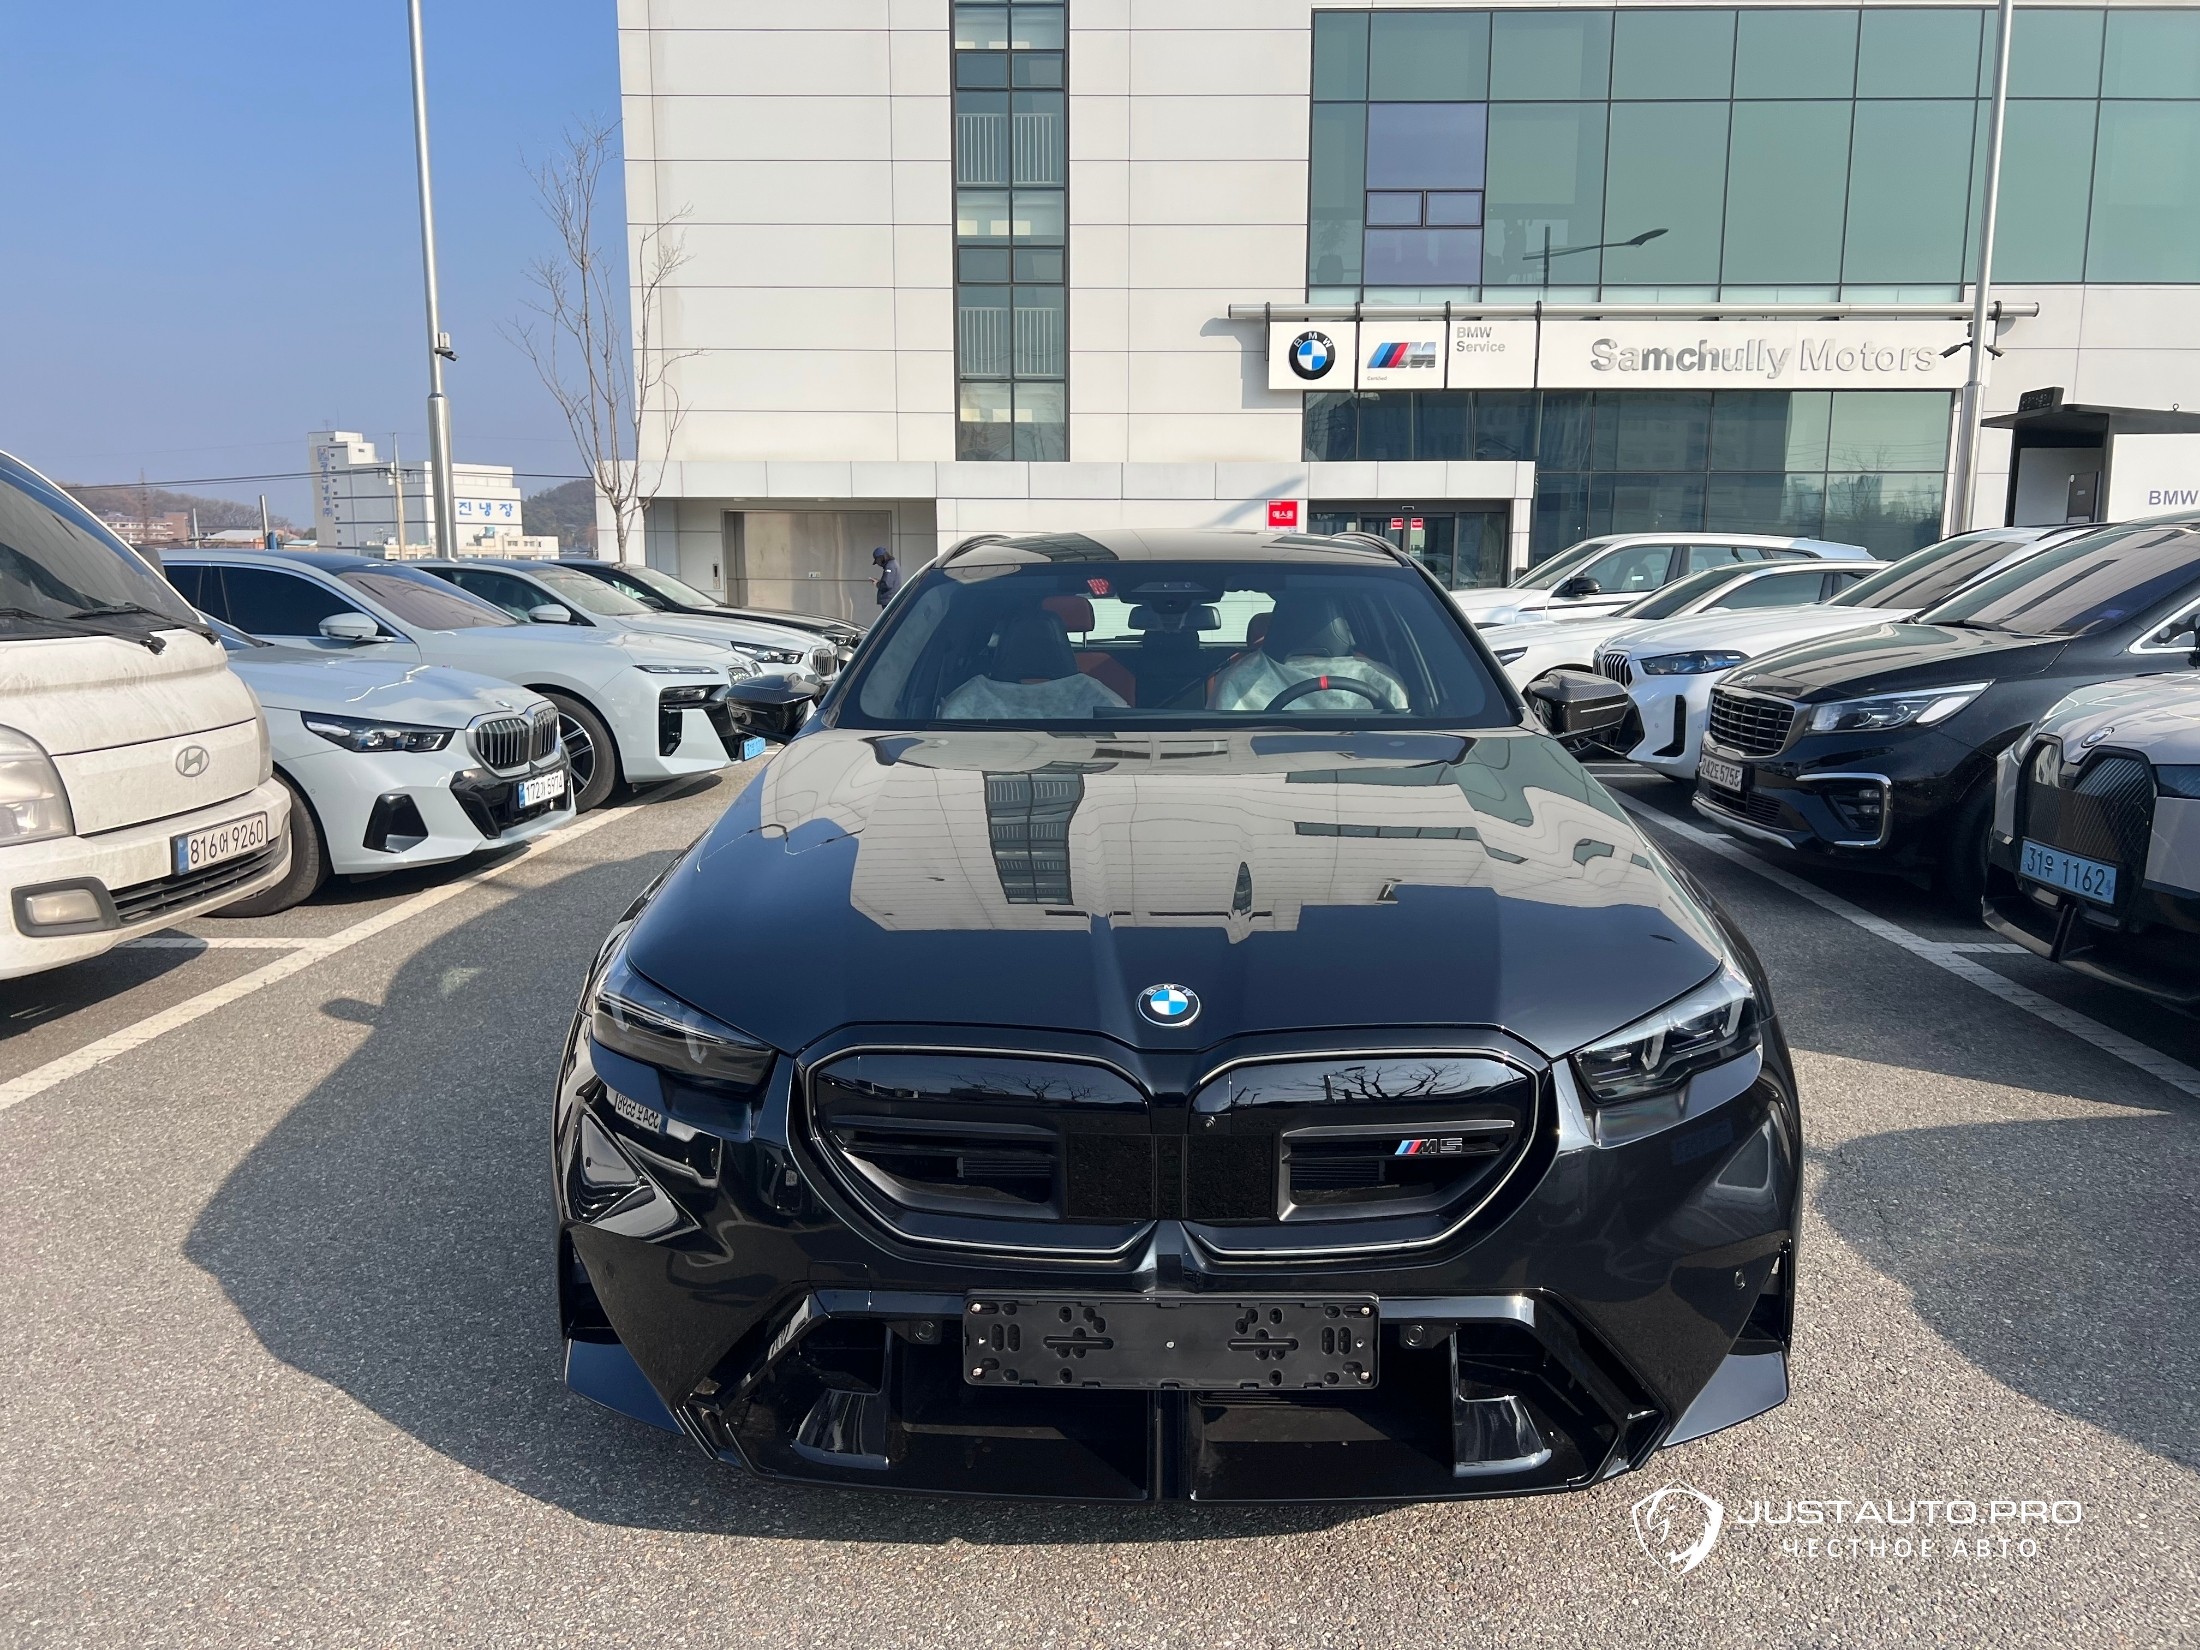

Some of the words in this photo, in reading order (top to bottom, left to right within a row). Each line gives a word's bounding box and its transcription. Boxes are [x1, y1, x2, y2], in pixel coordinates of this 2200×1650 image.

[1457, 327, 1492, 339] BMW
[1456, 341, 1505, 353] Service
[1590, 338, 1793, 379] Samchully
[1800, 338, 1936, 373] Motors
[2148, 490, 2199, 505] BMW
[458, 500, 514, 517] 진냉장
[1719, 764, 1741, 788] 5755
[190, 831, 228, 864] 816어
[232, 819, 263, 851] 9260
[2027, 845, 2054, 877] 31우
[2062, 858, 2105, 896] 1162
[1417, 1137, 1463, 1155] M5
